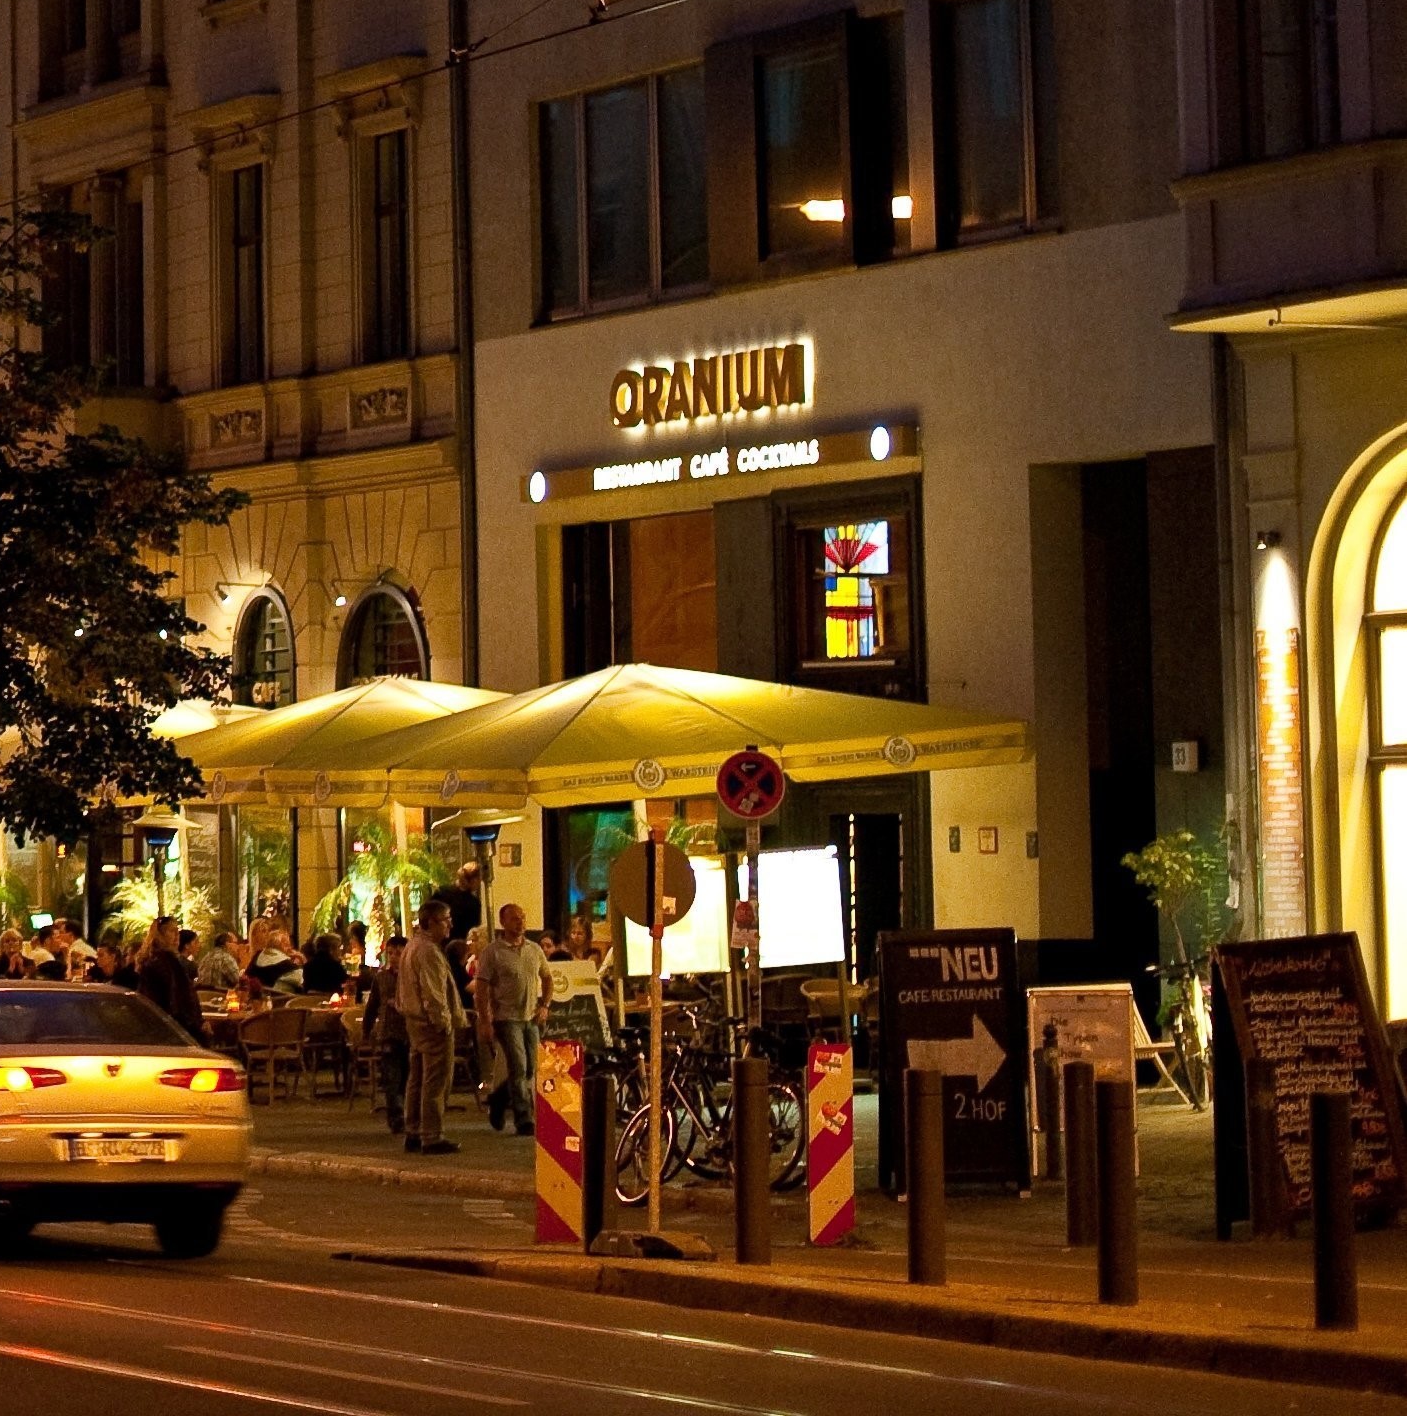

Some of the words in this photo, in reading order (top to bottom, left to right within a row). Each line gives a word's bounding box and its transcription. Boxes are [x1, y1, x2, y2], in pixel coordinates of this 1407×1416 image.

[610, 343, 806, 428] ORANIUM
[593, 457, 683, 491] RESTAURANT
[689, 446, 729, 479] CAFÉ
[736, 438, 820, 473] COCKTAILS
